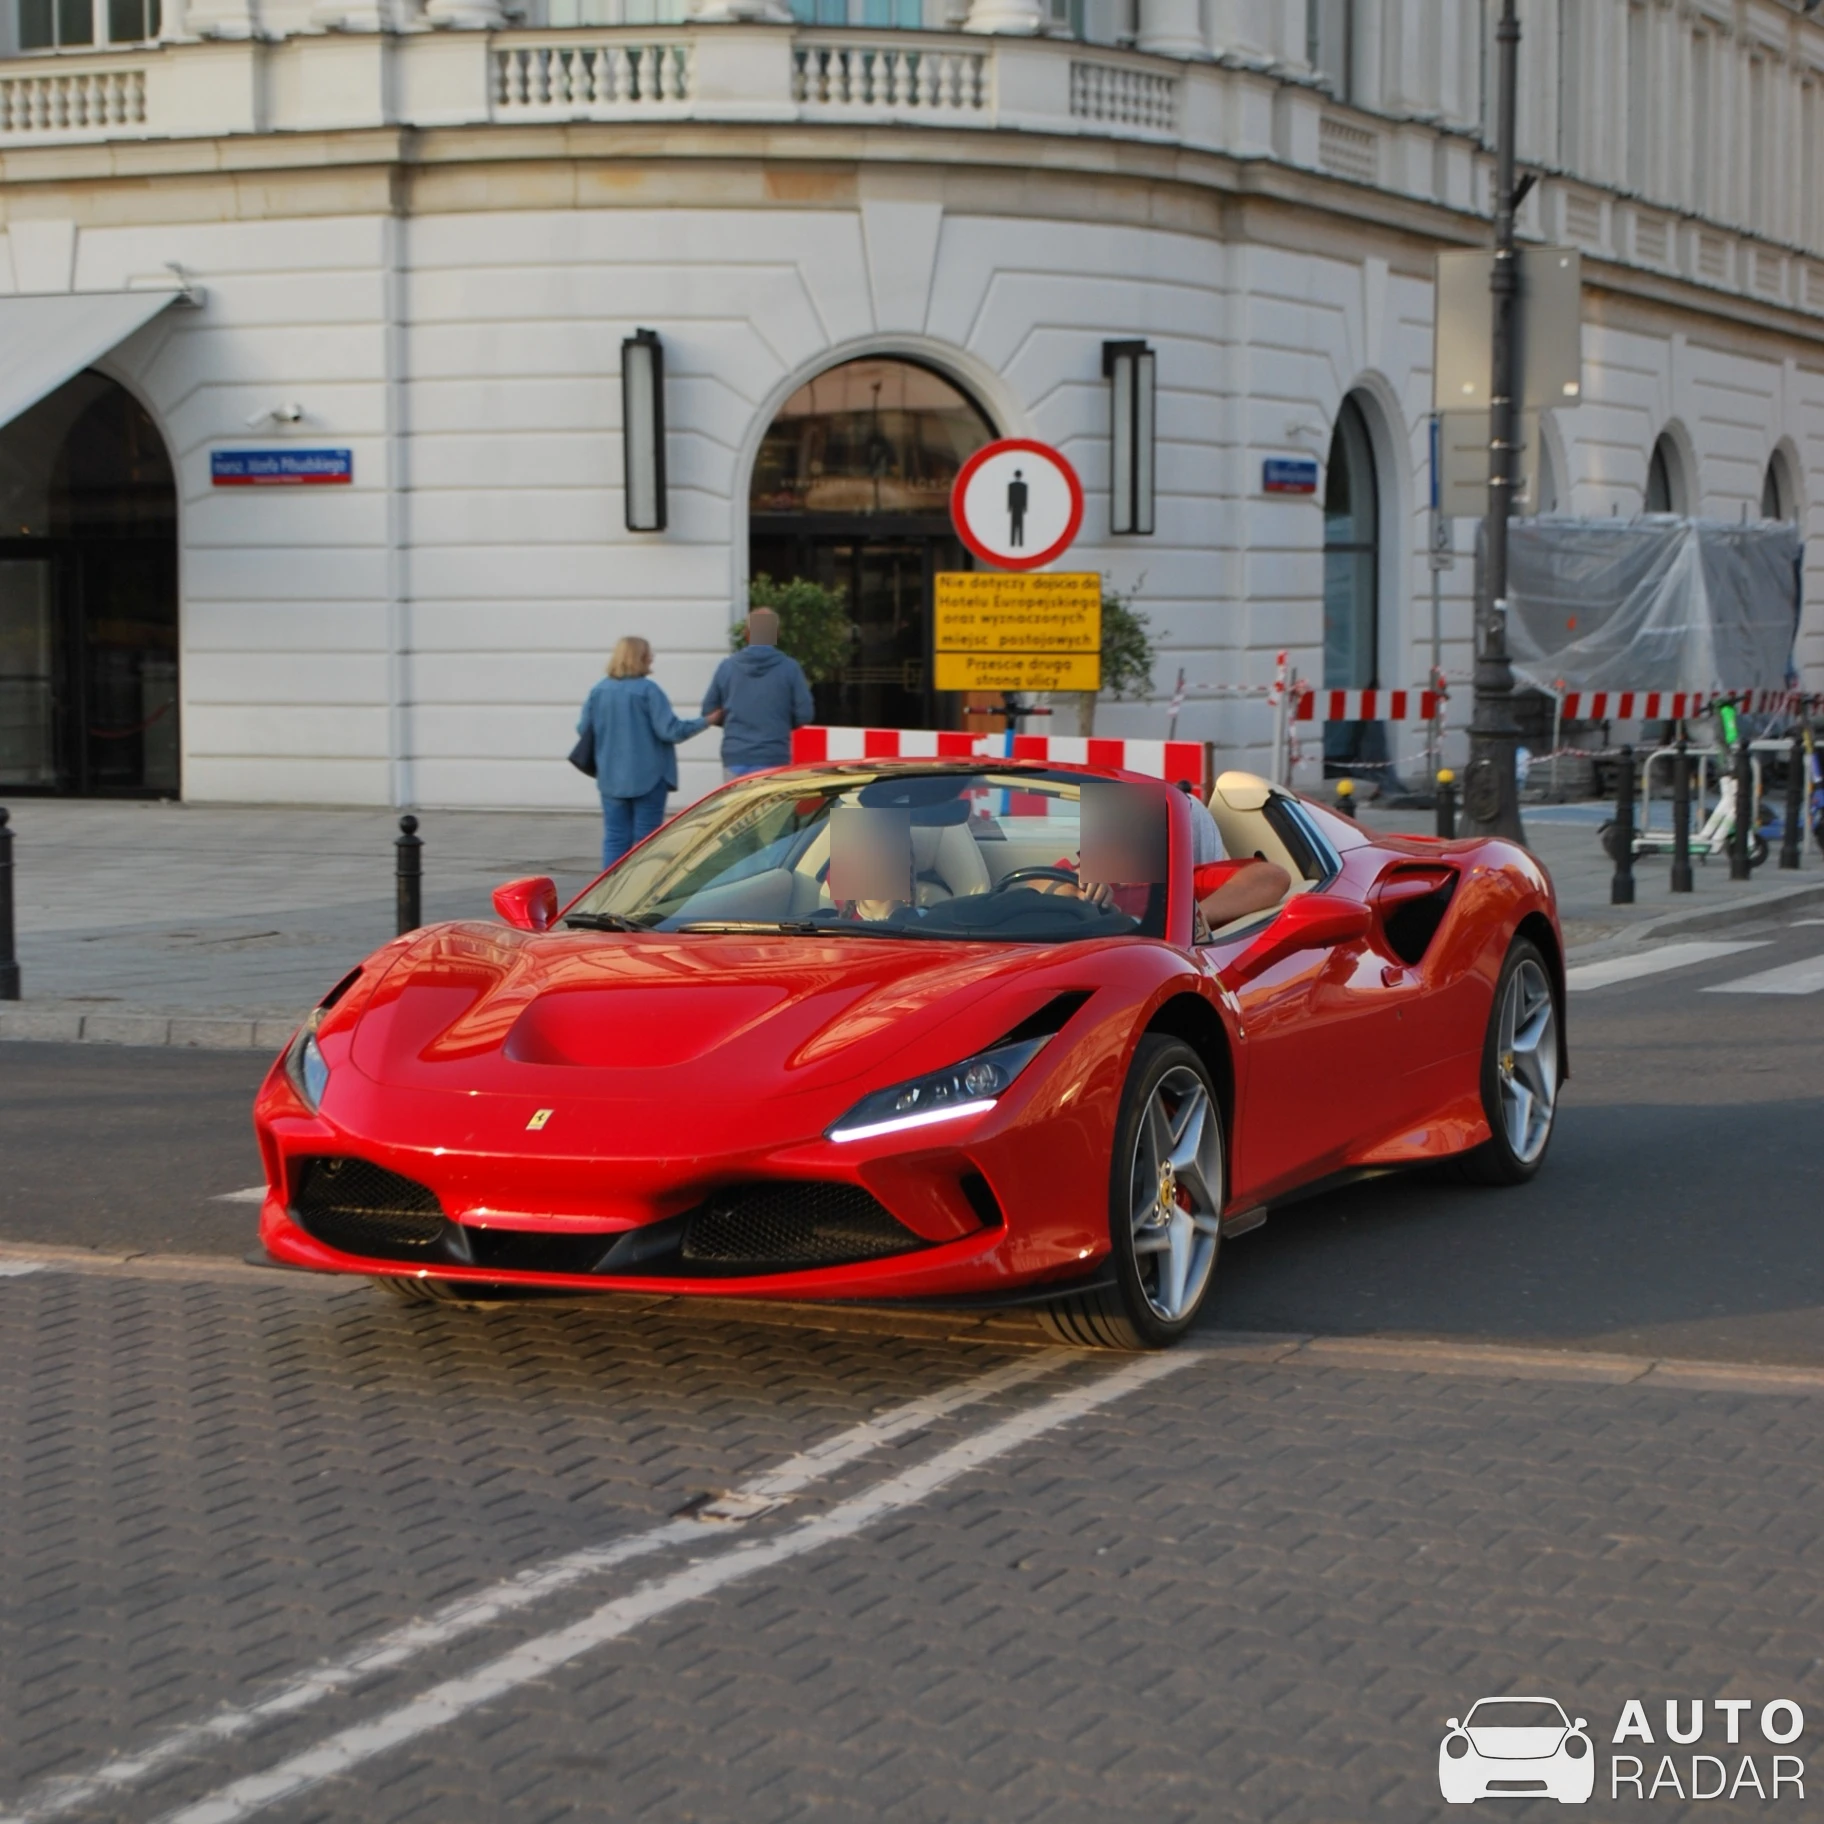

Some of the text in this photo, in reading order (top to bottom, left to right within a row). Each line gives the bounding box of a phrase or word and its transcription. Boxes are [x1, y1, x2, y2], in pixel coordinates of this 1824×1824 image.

[940, 577, 964, 589] Nie
[969, 577, 1025, 592] dotyczy
[1081, 577, 1100, 589] do
[939, 594, 1099, 611] Hotelu Europejskiego
[943, 612, 1086, 627] oraz wyznaczonych
[941, 633, 1093, 648] miejsc postojowych
[1025, 674, 1060, 689] ulicy
